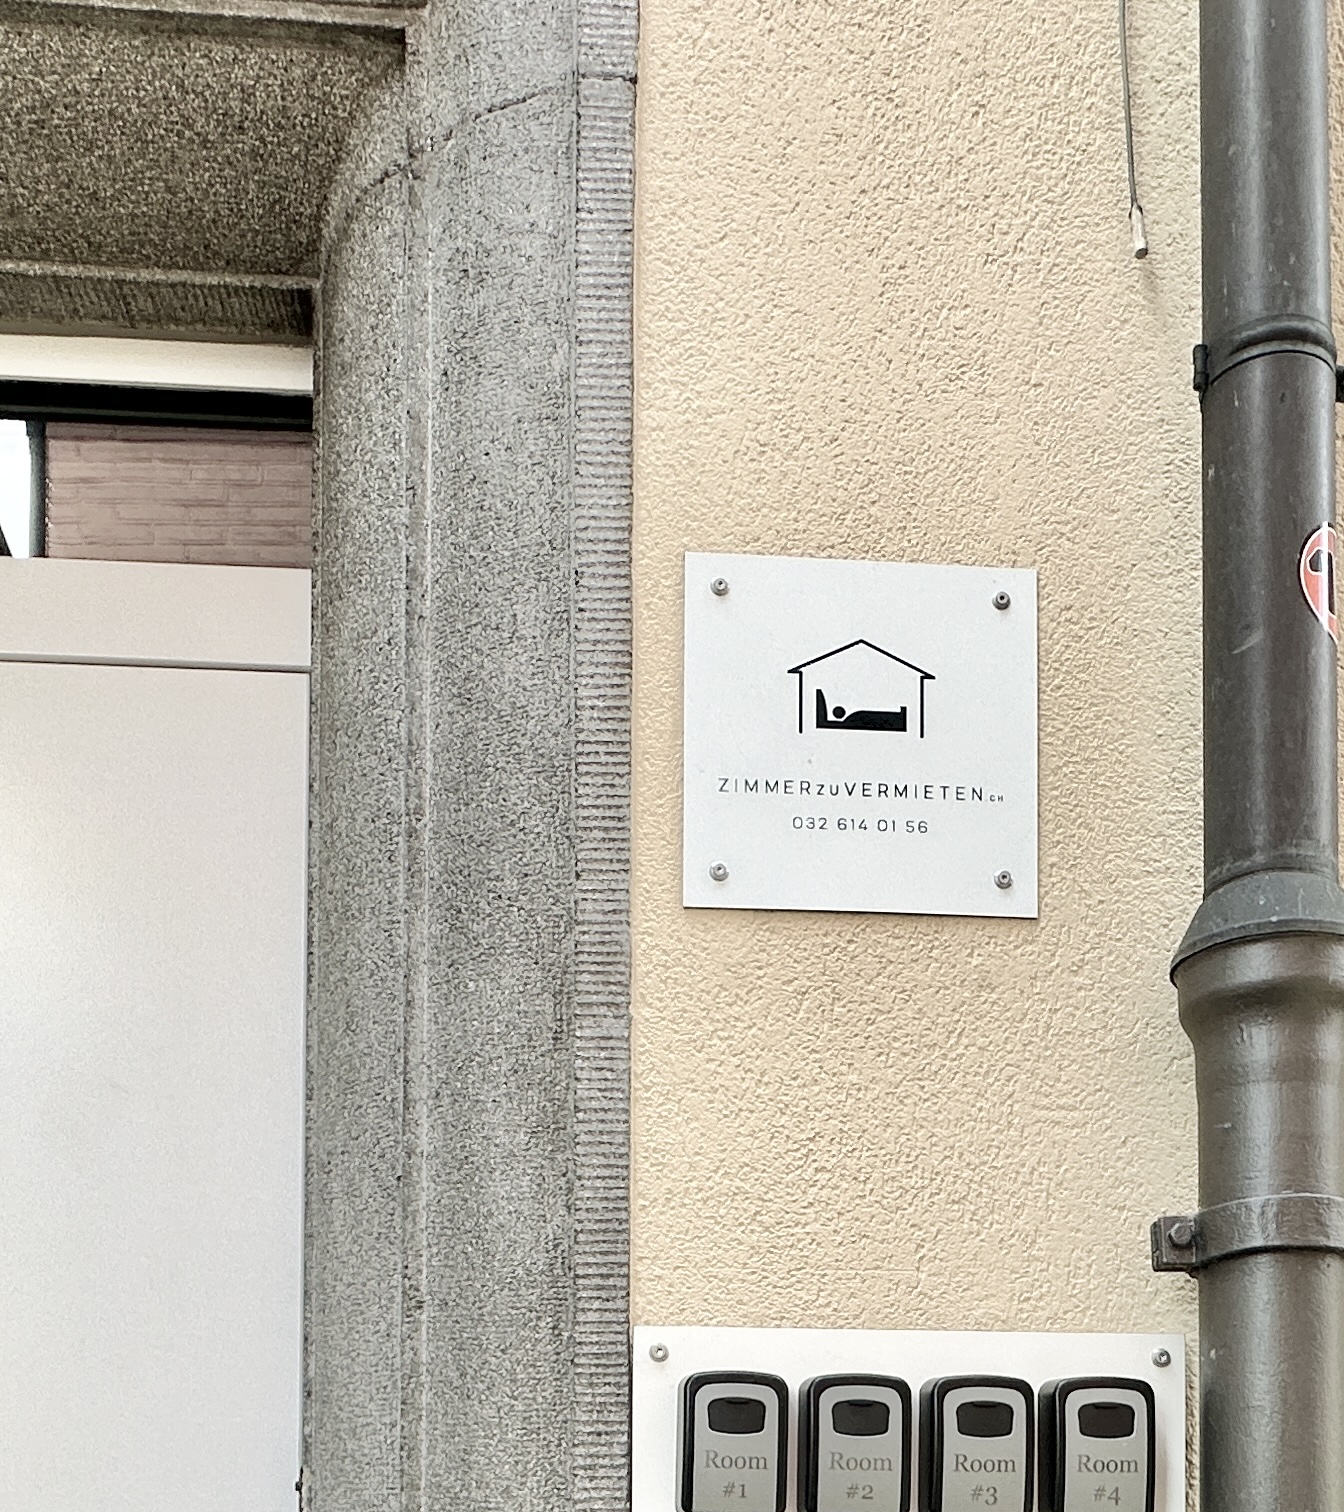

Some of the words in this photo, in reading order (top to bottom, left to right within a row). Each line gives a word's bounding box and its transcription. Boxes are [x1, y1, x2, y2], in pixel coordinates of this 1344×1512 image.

[792, 816, 828, 830] 032
[837, 817, 868, 831] 614
[877, 819, 896, 832] 01
[905, 820, 928, 833] 56
[704, 1449, 769, 1471] Room
[829, 1451, 894, 1473] Room
[953, 1453, 1017, 1475] Room
[1077, 1453, 1139, 1475] Room
[722, 1481, 748, 1499] #1
[845, 1483, 875, 1501] #2
[970, 1485, 999, 1506] #3
[1093, 1486, 1122, 1507] #4
